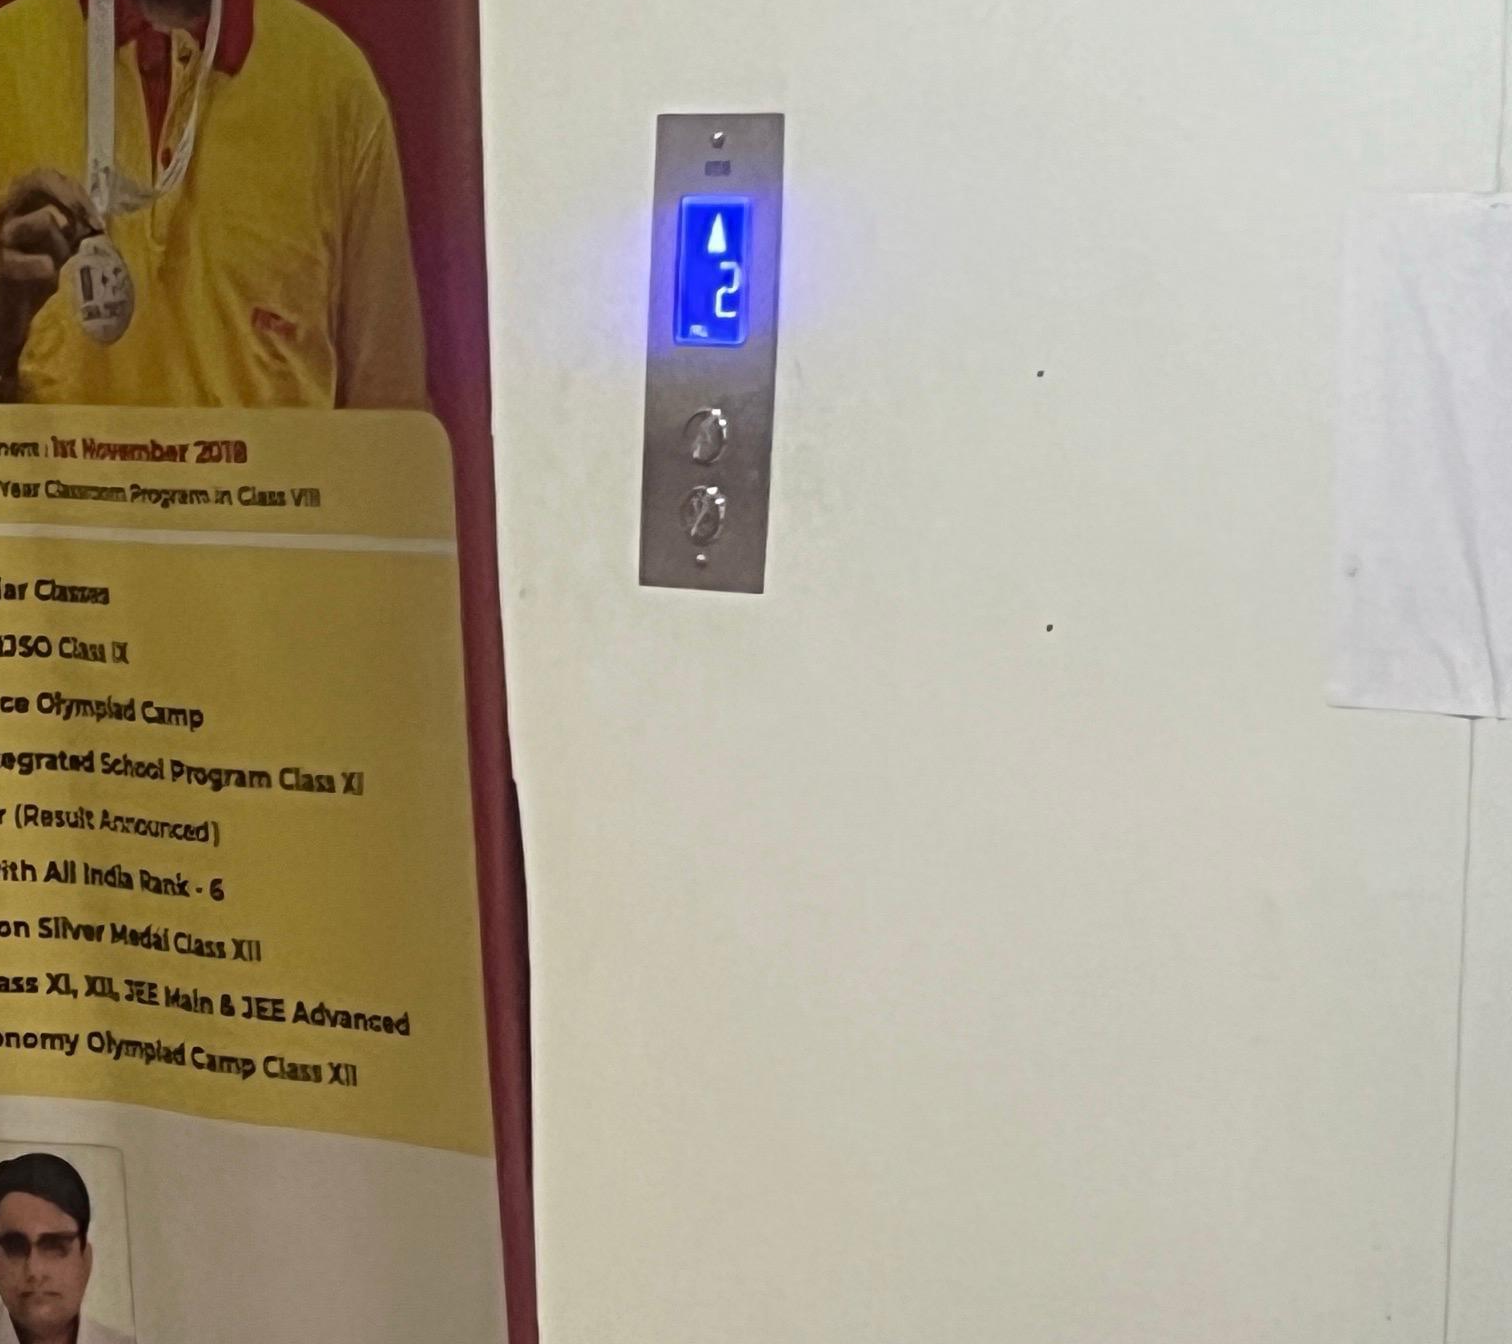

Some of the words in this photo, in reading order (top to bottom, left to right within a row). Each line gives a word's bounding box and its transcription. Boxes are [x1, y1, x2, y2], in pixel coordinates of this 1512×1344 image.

[714, 261, 742, 318] 2
[36, 691, 135, 723] Olympiad
[141, 701, 204, 732] Camp
[101, 752, 164, 782] School
[170, 760, 272, 791] Program
[279, 768, 336, 793] Class
[14, 803, 95, 830] (Result
[44, 860, 76, 886] All
[84, 865, 133, 890] India
[209, 878, 225, 902] 6
[38, 917, 104, 942] Silver
[111, 923, 169, 952] Medal
[174, 931, 226, 957] Class
[125, 979, 157, 1005] JEE
[241, 995, 286, 1023] JEE
[292, 1002, 411, 1036] Advanced
[87, 1031, 185, 1066] Olympiad
[191, 1046, 256, 1081] Camp
[263, 1056, 322, 1084] Class
